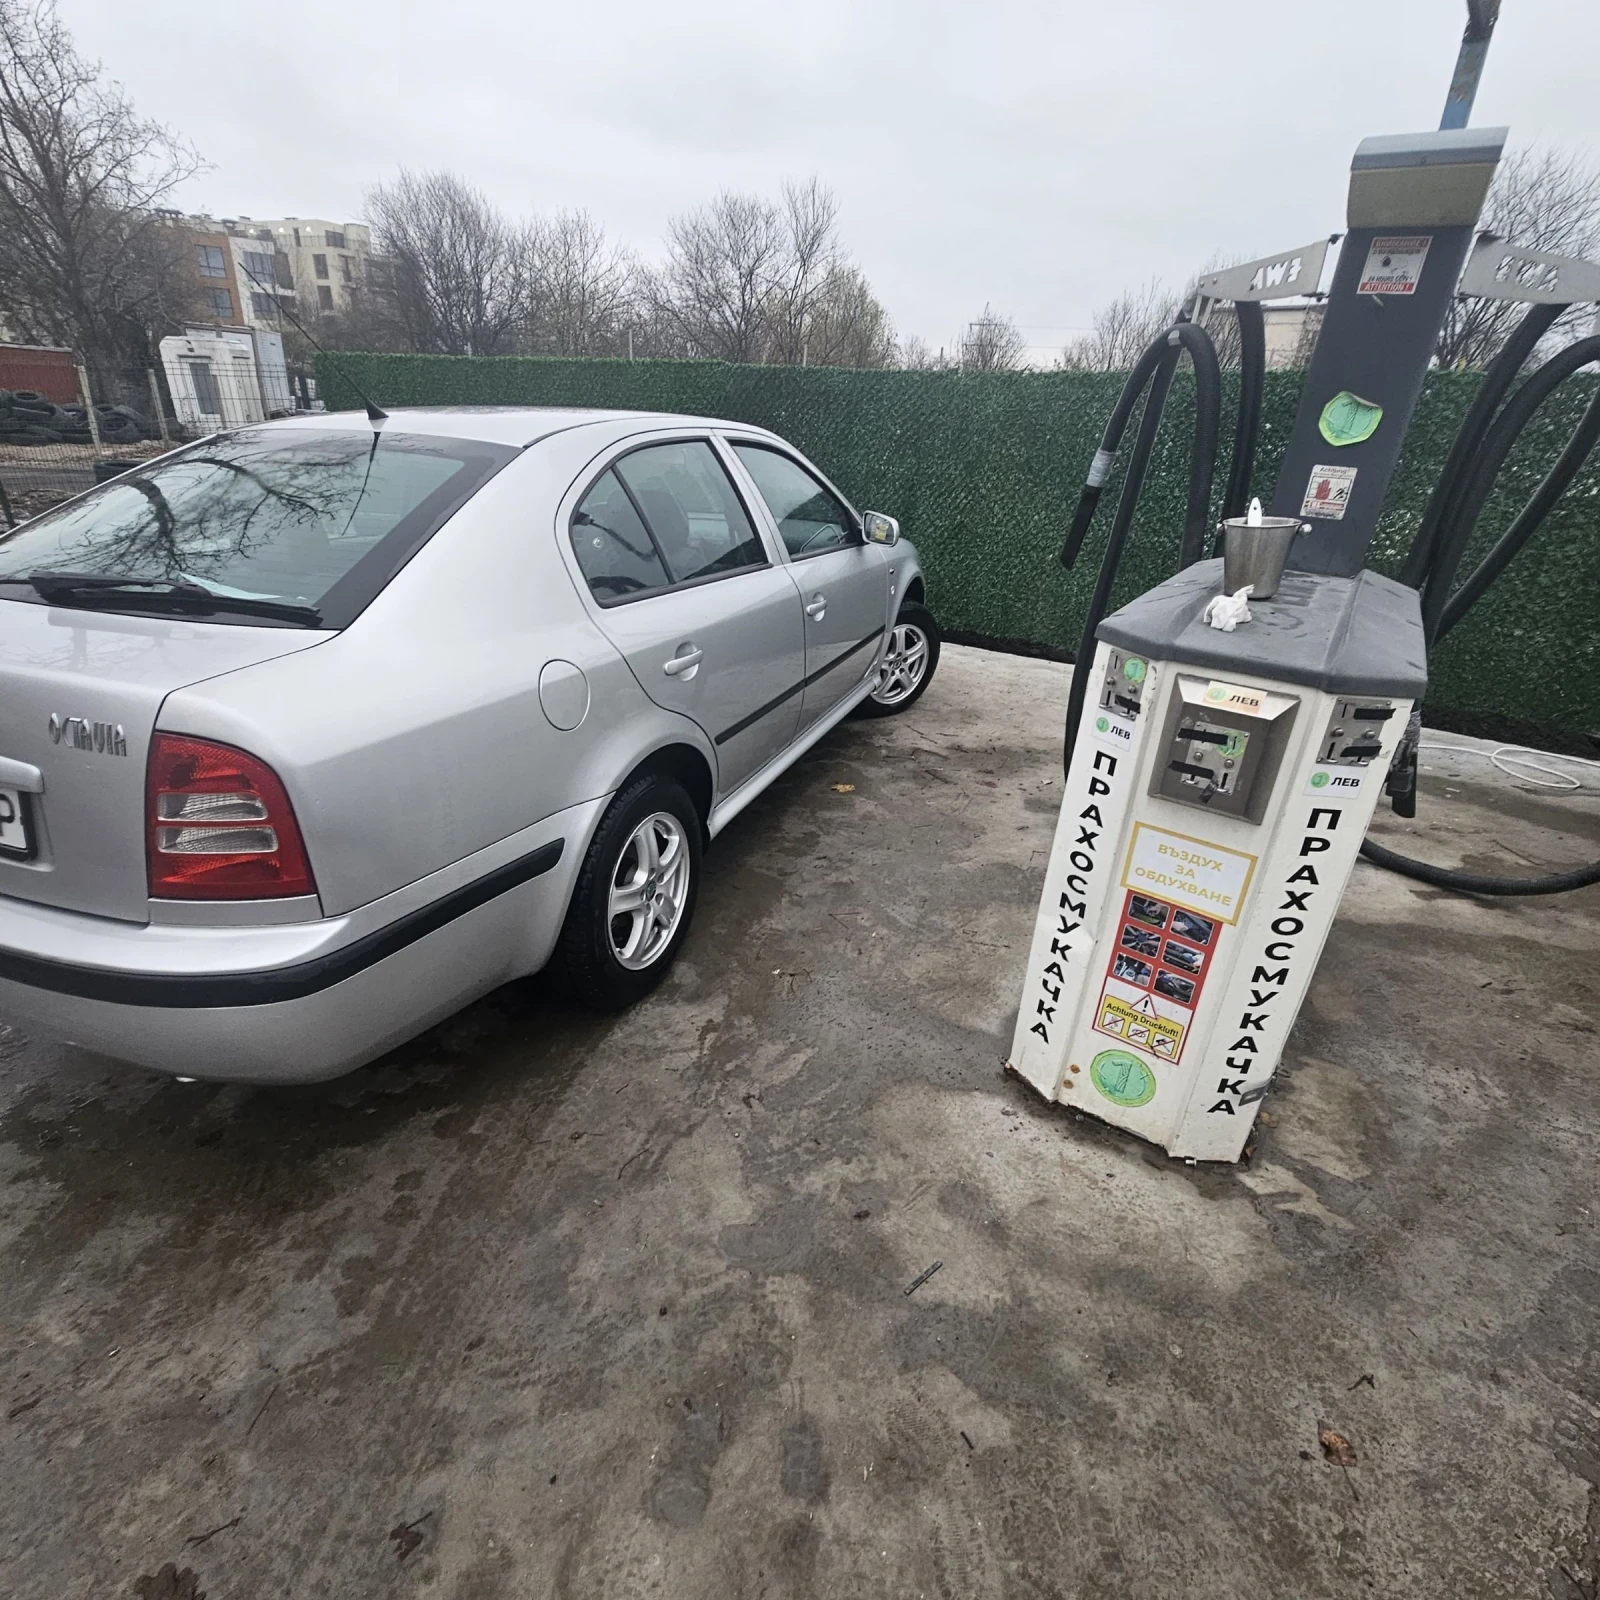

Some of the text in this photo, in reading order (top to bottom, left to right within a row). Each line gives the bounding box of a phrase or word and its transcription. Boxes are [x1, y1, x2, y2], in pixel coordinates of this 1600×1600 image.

[1364, 283, 1405, 292] ATTENTION
[1229, 695, 1260, 707] ЛЕВ
[48, 712, 128, 757] OCTAVIA
[1110, 725, 1131, 740] ЛЕВ
[1330, 777, 1361, 788] ЛЕВ
[1157, 843, 1225, 873] ВЪЗДУХ
[1174, 864, 1196, 879] ЗА
[1030, 750, 1118, 1044] ПРАХОСМУКАЧКА
[1134, 866, 1233, 907] ОБДУХВАНЕ
[1206, 808, 1343, 1116] ПРАХОСМУКАЧКА
[1106, 1002, 1180, 1038] Achtung Druckluft!
